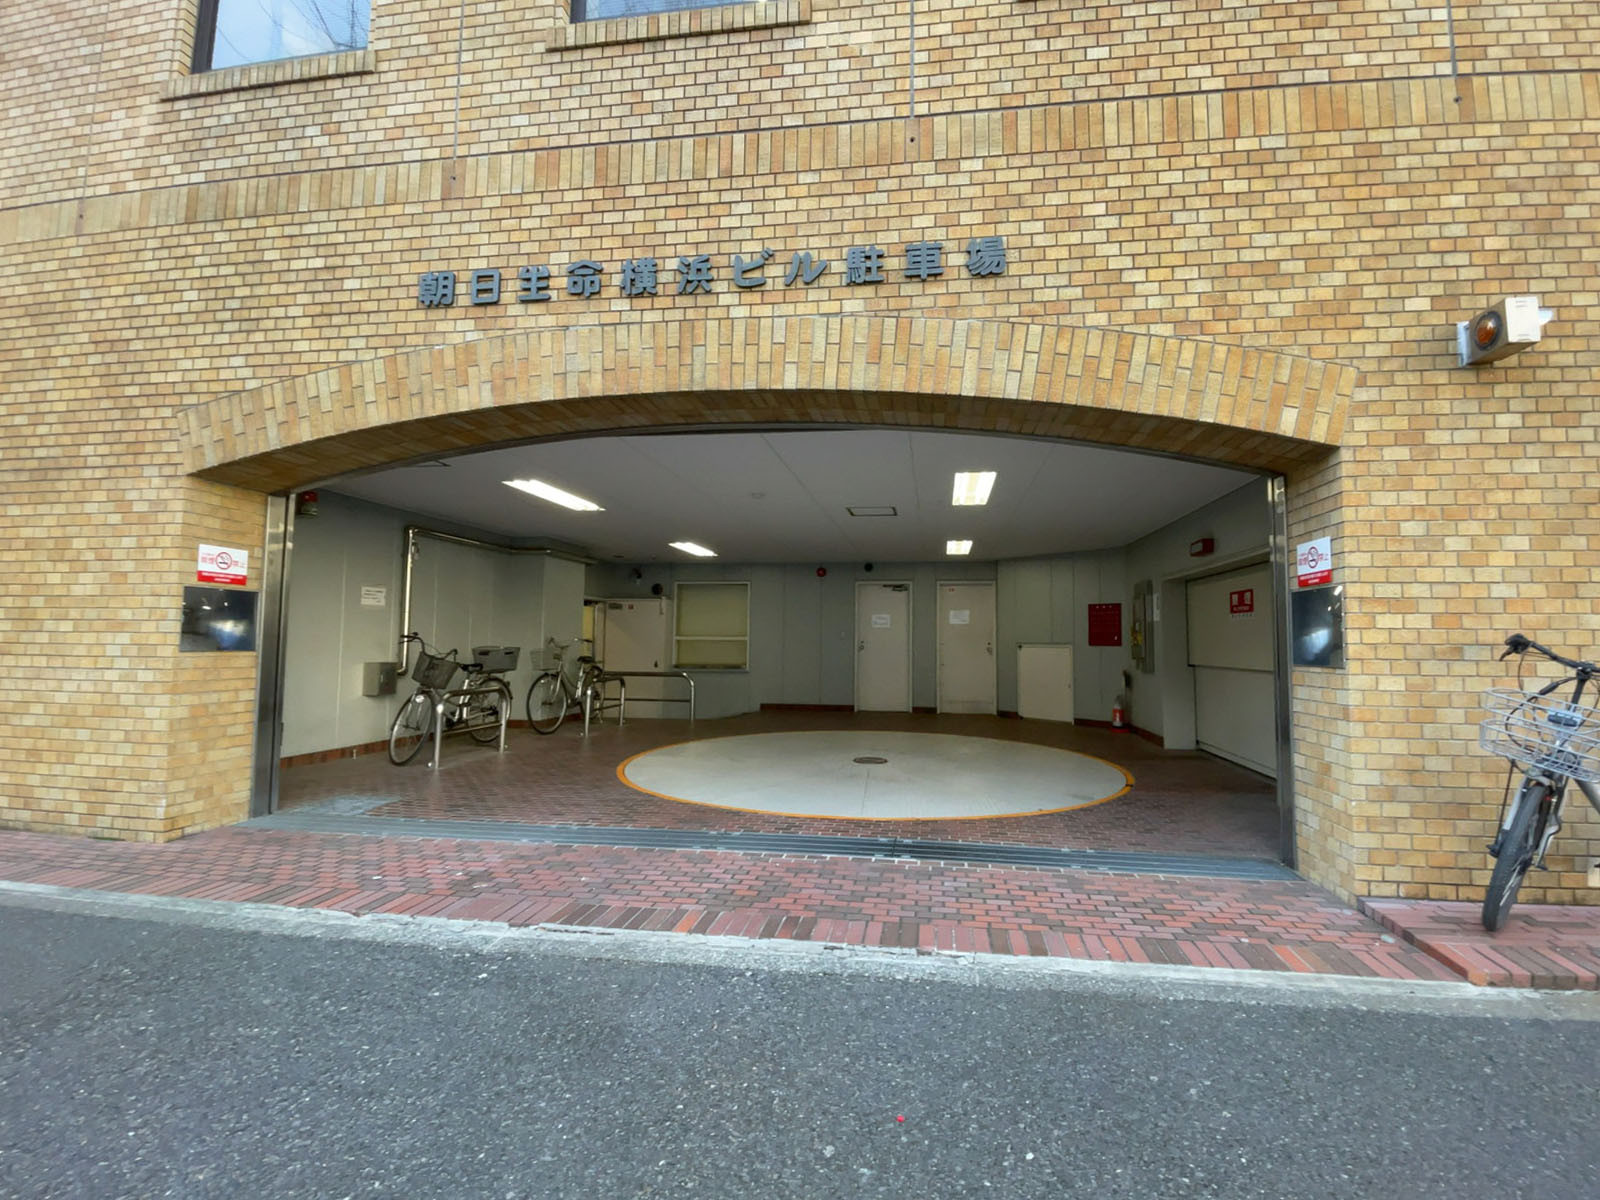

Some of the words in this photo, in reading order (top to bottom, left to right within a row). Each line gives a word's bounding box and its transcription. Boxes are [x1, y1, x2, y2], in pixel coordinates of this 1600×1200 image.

[419, 236, 1006, 307] 朝日生命横浜ビル駐車場
